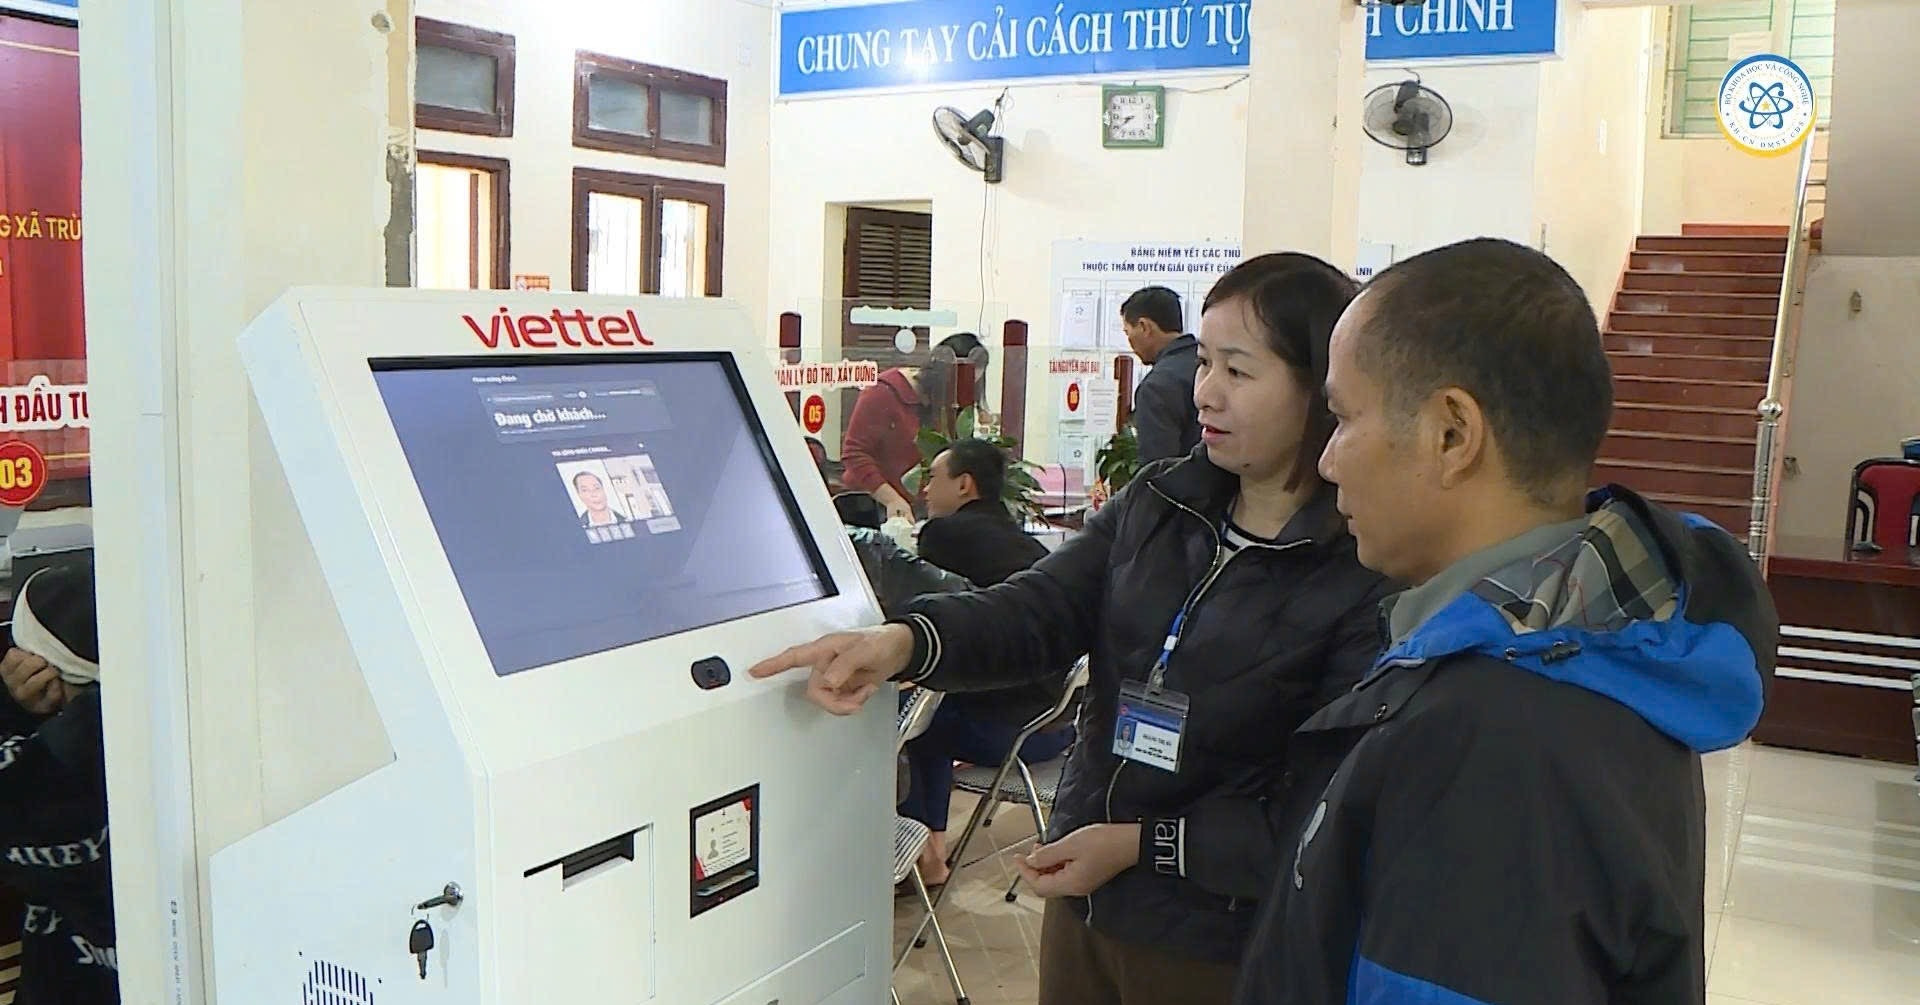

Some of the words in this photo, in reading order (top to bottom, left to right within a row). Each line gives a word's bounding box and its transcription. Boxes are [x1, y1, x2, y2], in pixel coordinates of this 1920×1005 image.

[798, 29, 890, 75] CHUNG
[900, 25, 960, 65] TAY
[967, 5, 1020, 61] CẢI
[1026, 3, 1114, 57] CÁCH
[1201, 3, 1250, 55] TỤ
[15, 211, 42, 238] XÃ
[462, 306, 654, 348] viettel
[15, 383, 62, 422] ĐẦU
[808, 405, 822, 424] 05
[494, 412, 532, 428] Đang
[0, 457, 33, 489] 03
